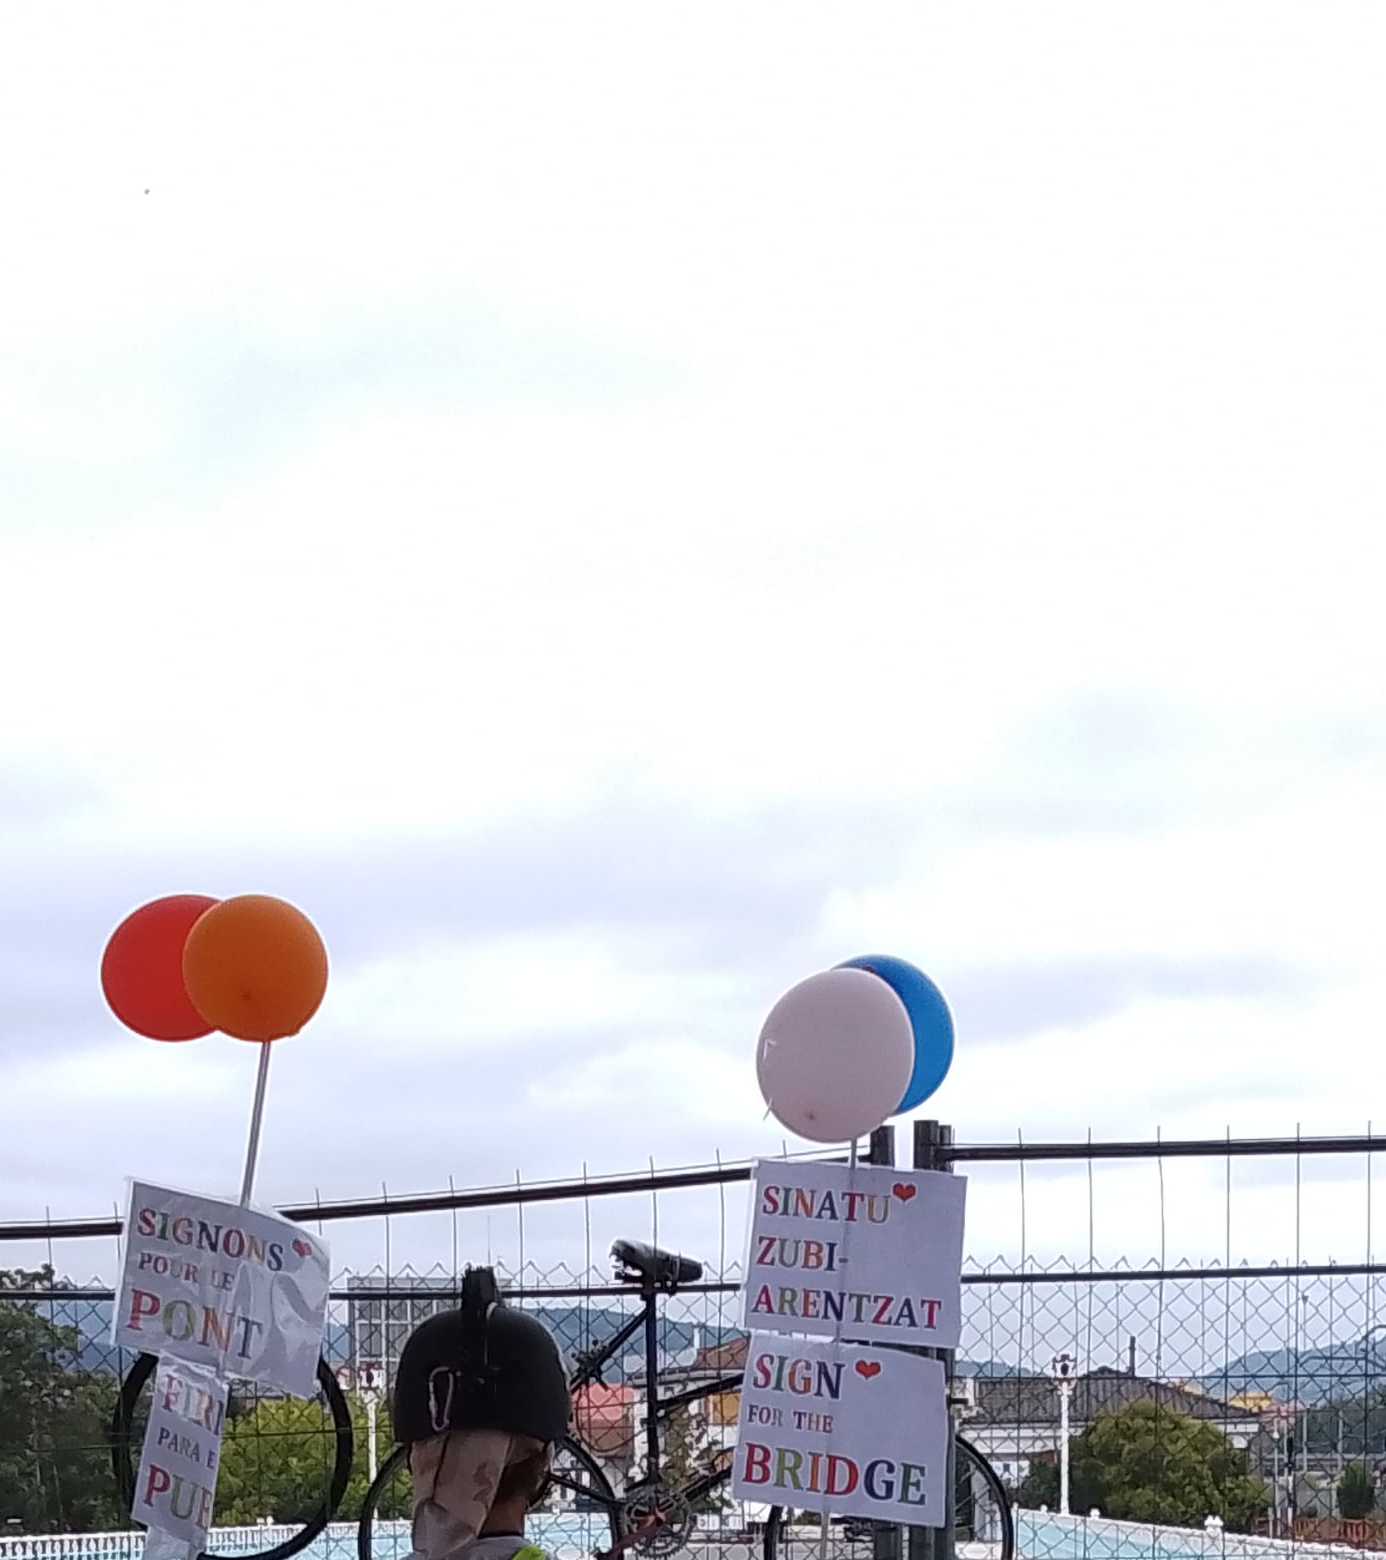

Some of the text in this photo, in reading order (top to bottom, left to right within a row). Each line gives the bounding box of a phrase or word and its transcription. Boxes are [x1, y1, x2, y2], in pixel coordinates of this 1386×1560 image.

[762, 1185, 892, 1224] SINATU
[137, 1208, 284, 1272] SIGNONS
[756, 1235, 849, 1273] ZUBI-
[138, 1252, 235, 1292] POUR LE
[125, 1288, 264, 1360] PONT
[750, 1284, 942, 1330] ARENTZAT
[752, 1353, 846, 1400] SIGN
[747, 1404, 834, 1434] FOR THE
[157, 1426, 201, 1463] PARA
[741, 1442, 926, 1507] BRIDGE
